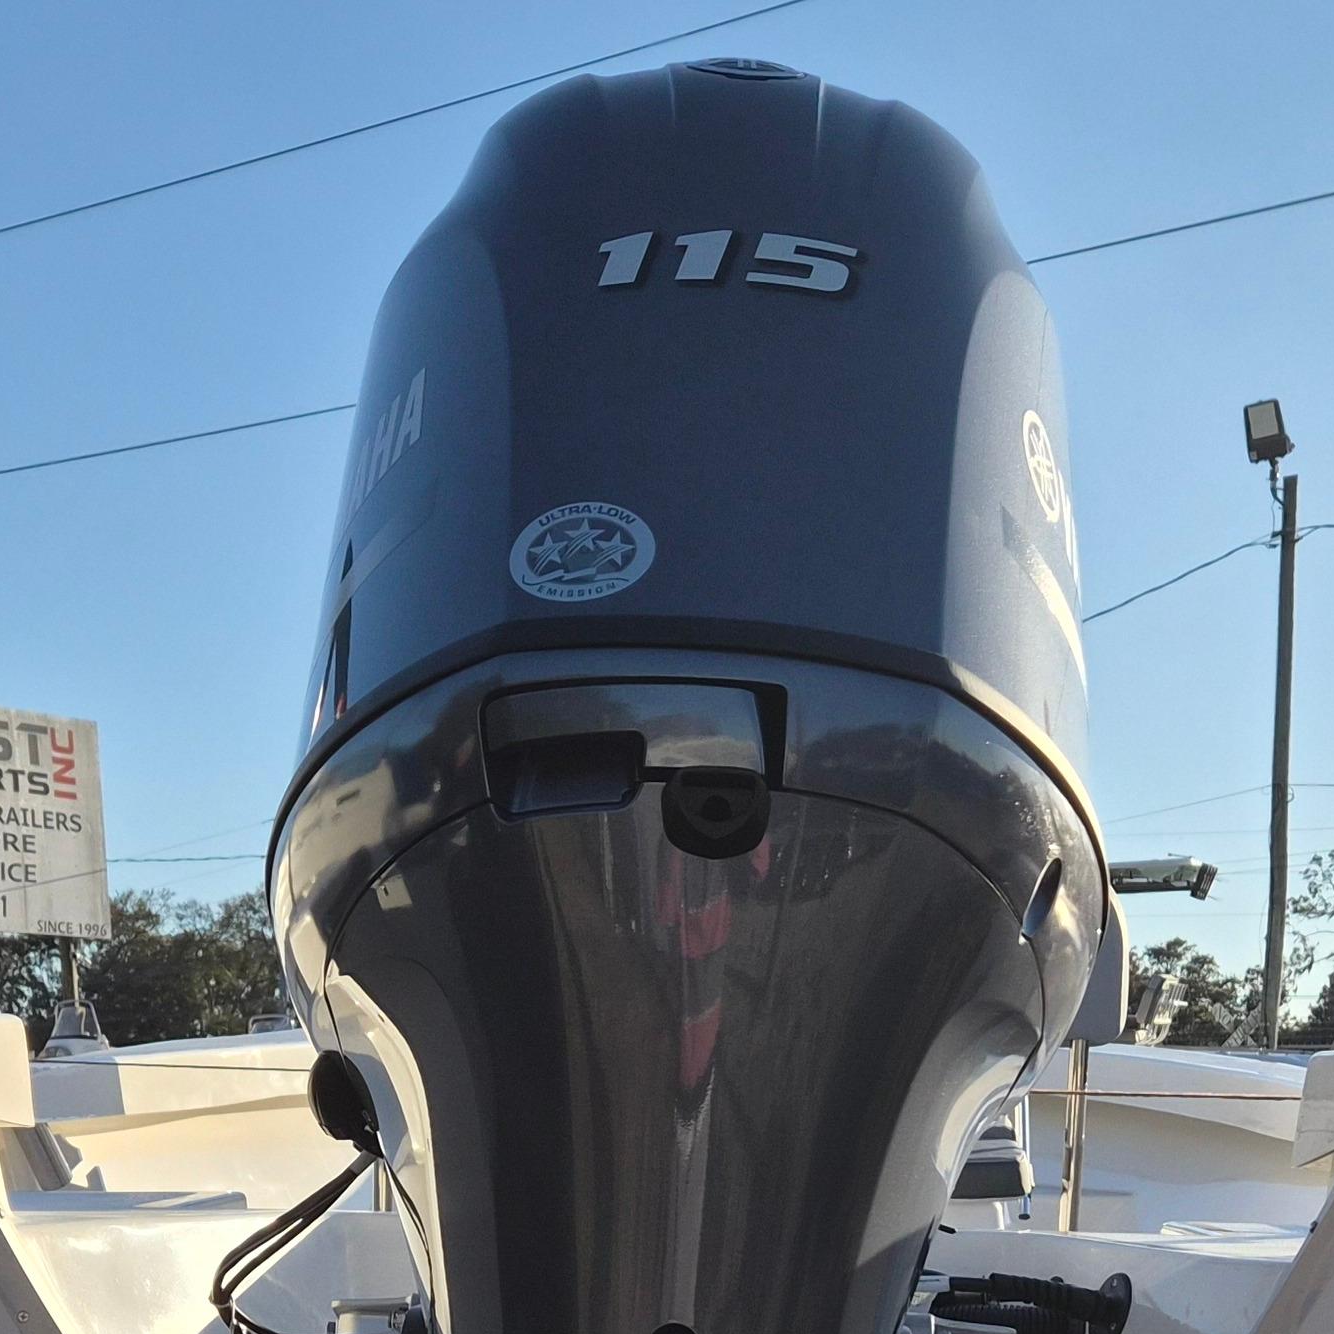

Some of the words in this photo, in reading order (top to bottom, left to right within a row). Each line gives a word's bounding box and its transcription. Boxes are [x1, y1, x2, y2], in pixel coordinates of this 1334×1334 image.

[598, 229, 859, 293] 115
[536, 582, 617, 598] EMISSION
[50, 726, 78, 801] INC
[36, 919, 74, 935] SINCE
[78, 922, 108, 937] 1996
